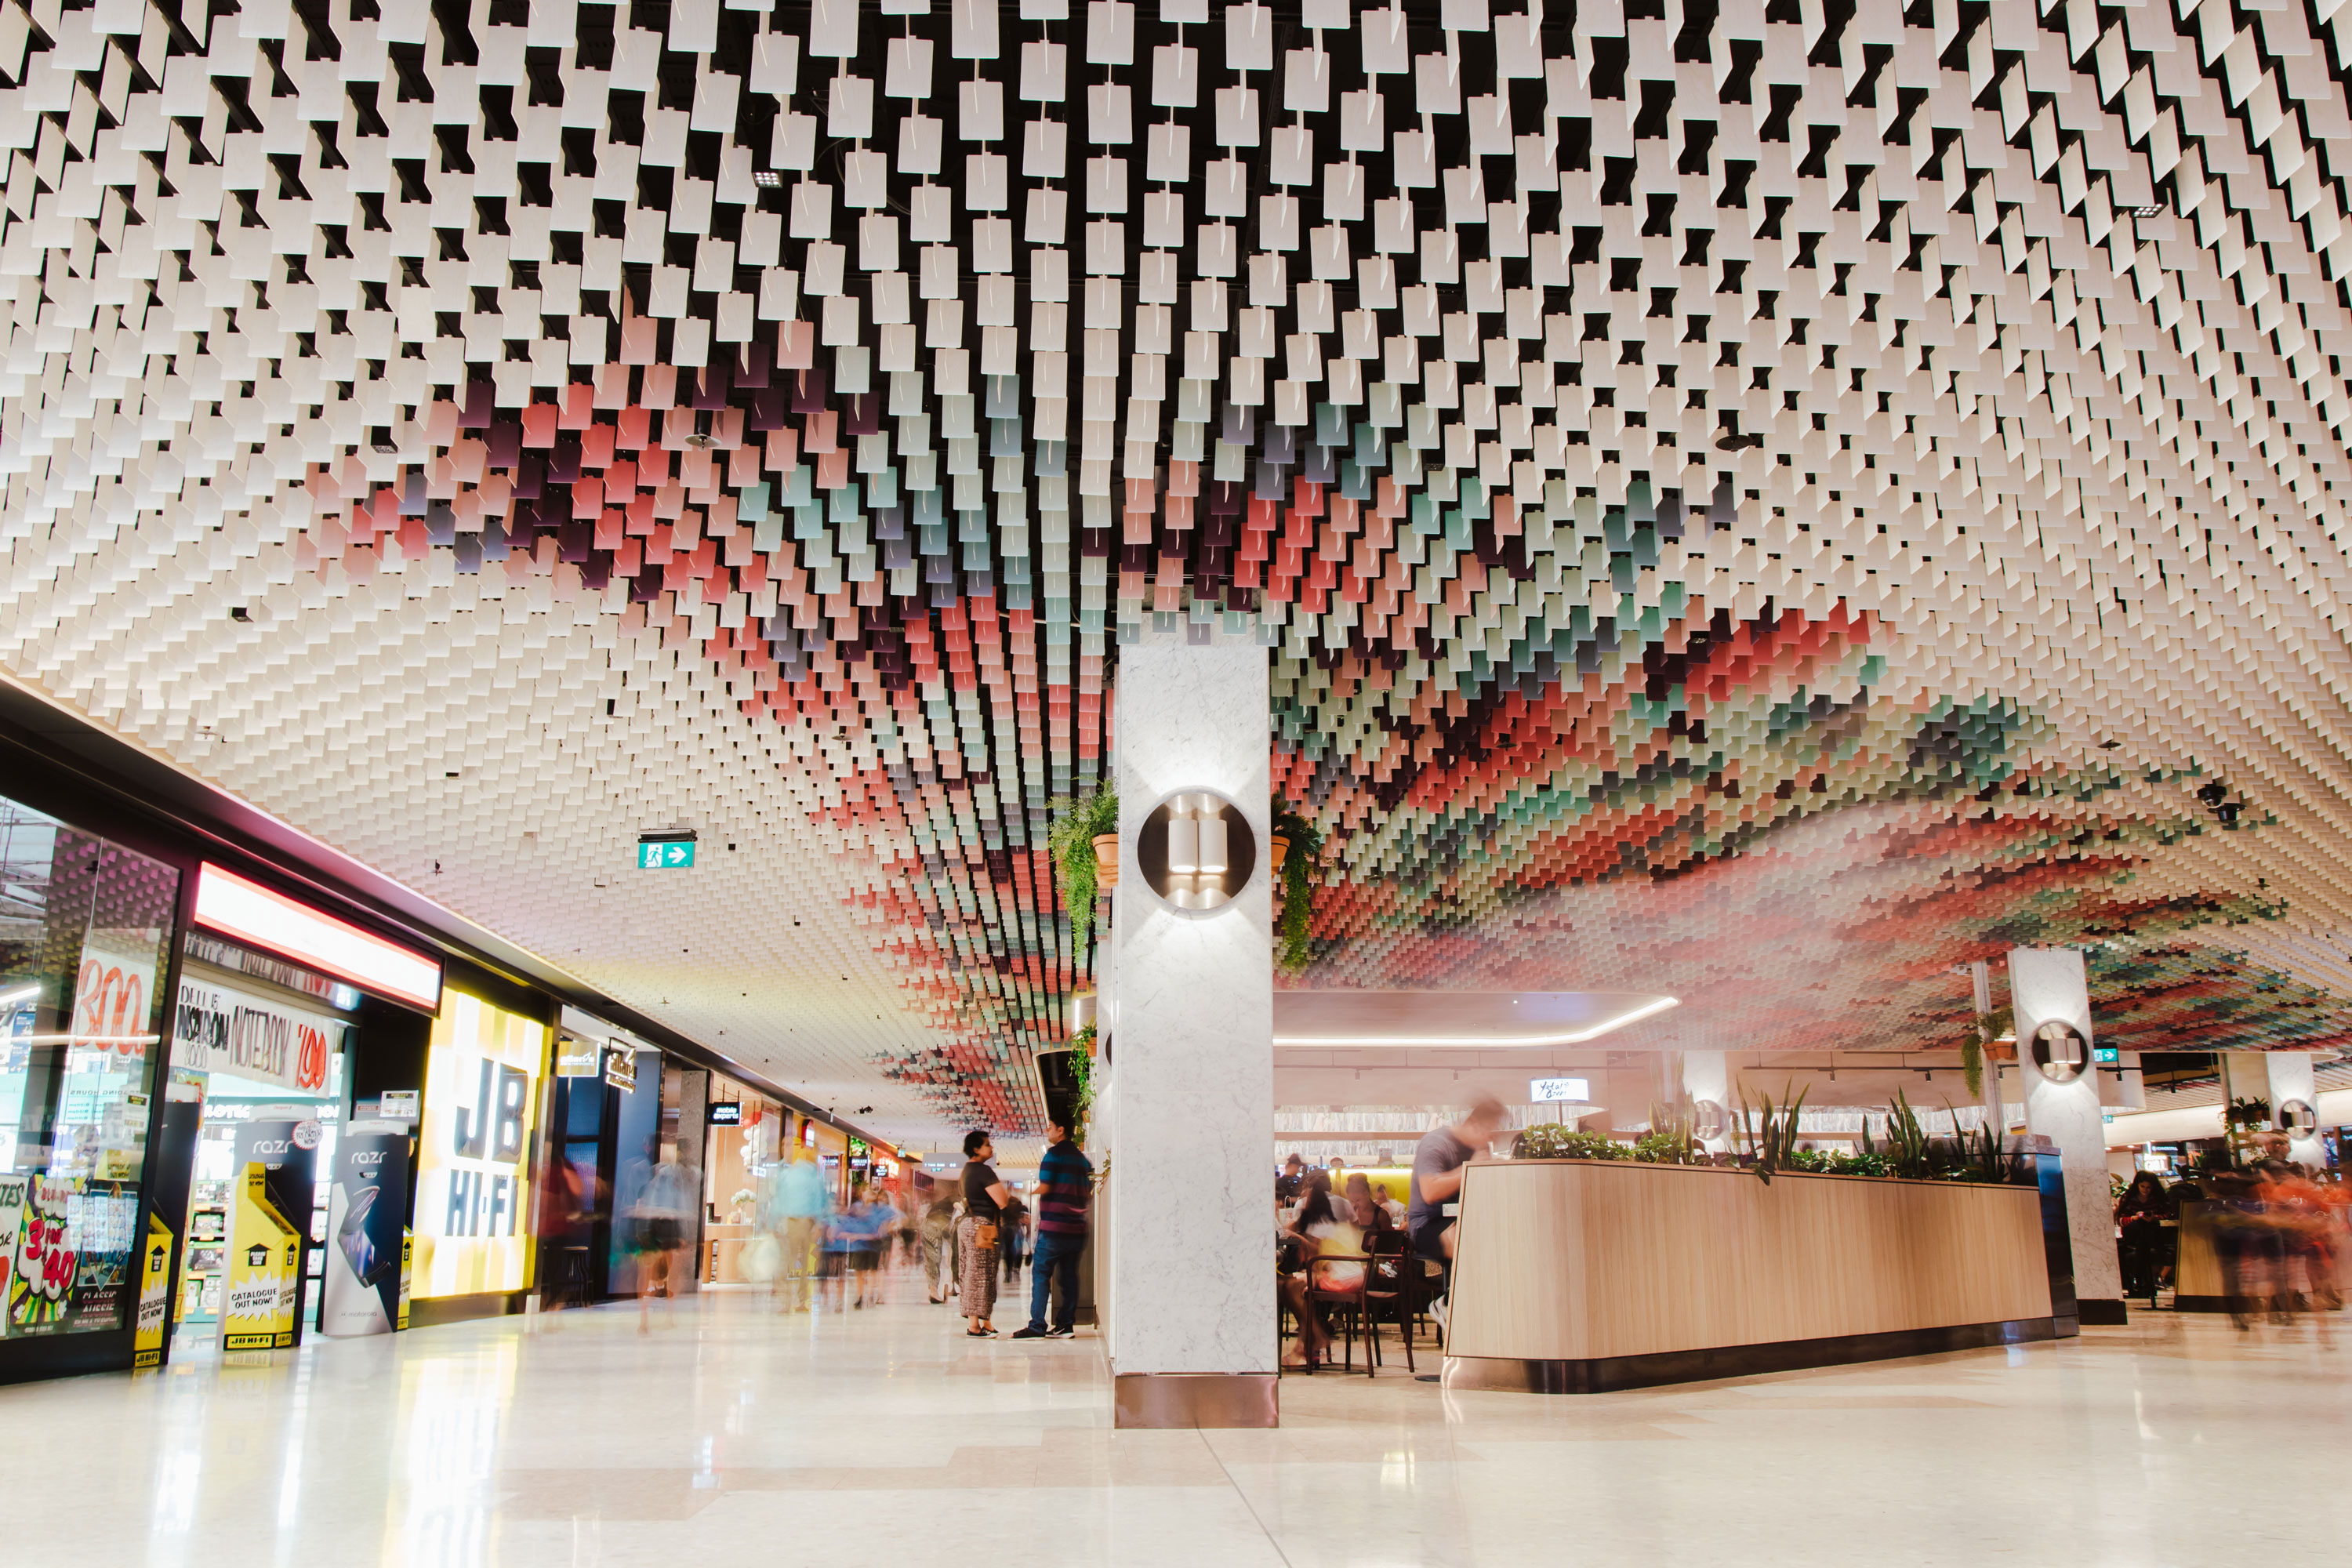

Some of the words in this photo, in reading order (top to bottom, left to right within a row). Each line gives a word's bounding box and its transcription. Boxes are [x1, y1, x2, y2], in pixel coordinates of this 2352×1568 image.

[180, 985, 206, 1007] DELL
[176, 1004, 229, 1051] NSPIRON
[453, 1057, 528, 1166] JB
[252, 1140, 293, 1155] razr
[351, 1151, 387, 1164] razr
[26, 1218, 45, 1261] 3
[45, 1227, 62, 1245] FOR
[231, 1288, 278, 1301] CATALOGUE
[140, 1296, 167, 1312] CATALOGUE
[235, 1300, 250, 1308] OUT
[253, 1297, 273, 1306] NOW!
[140, 1311, 150, 1322] OUT
[136, 1354, 145, 1363] JB
